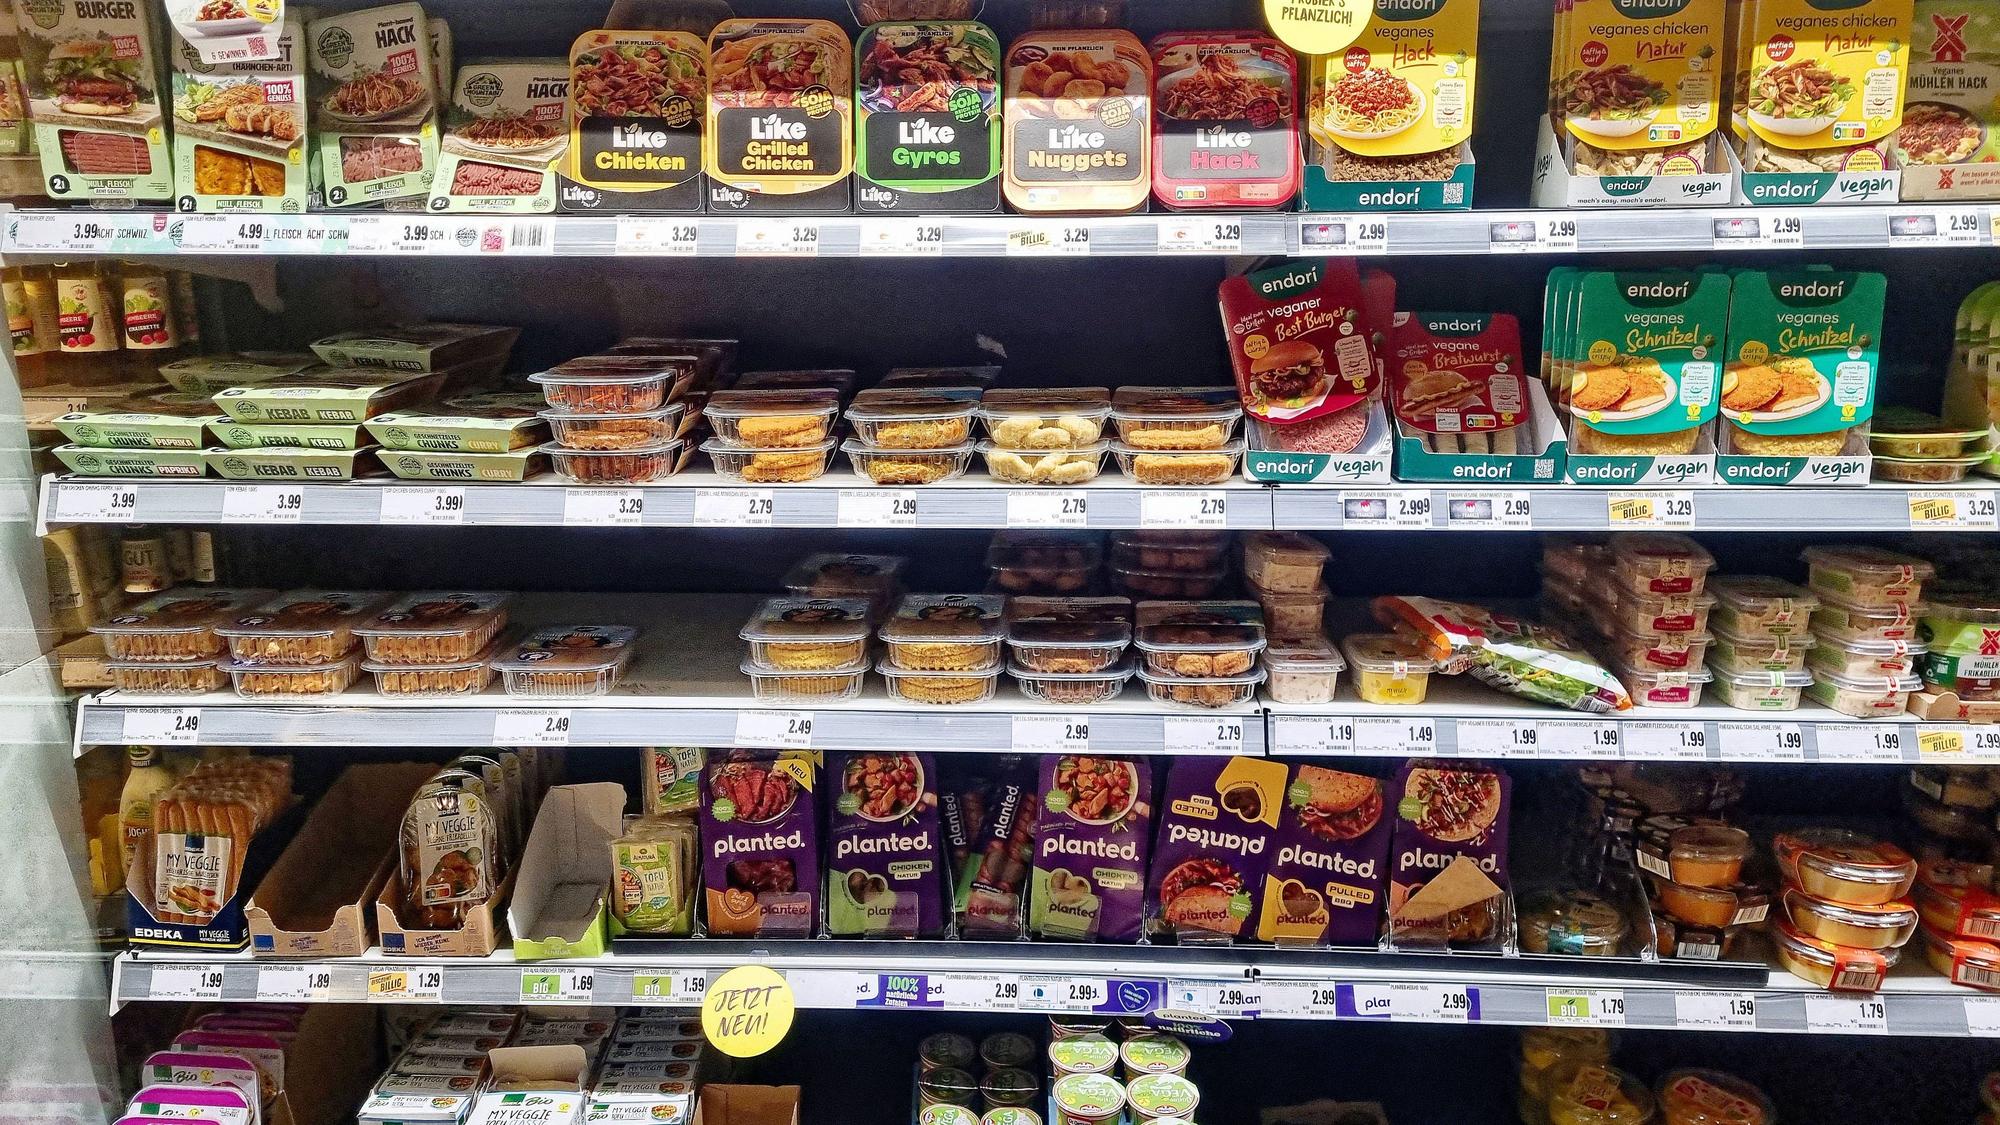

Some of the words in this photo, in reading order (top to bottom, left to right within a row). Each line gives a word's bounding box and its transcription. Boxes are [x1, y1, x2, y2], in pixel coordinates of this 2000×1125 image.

[76, 1, 136, 19] BURGER
[1282, 8, 1352, 27] PFLANZLICH!
[1776, 16, 1838, 31] veganes
[1842, 14, 1896, 27] chicken
[376, 25, 416, 48] HACK
[1374, 25, 1434, 41] veganes
[1589, 25, 1649, 38] veganes
[1653, 24, 1709, 35] chicken
[113, 37, 138, 49] 100%
[390, 52, 416, 67] 100%
[1393, 41, 1436, 66] Hack
[232, 61, 293, 73] (HÄHNCHEN-ART)
[1933, 67, 1964, 75] Veganes
[265, 84, 292, 96] 100%
[527, 82, 568, 98] HACK
[1910, 76, 1954, 89] MÜHLEN
[1959, 77, 1988, 89] HACK
[267, 95, 292, 103] GENUSS
[534, 106, 561, 117] 100%
[751, 114, 807, 140] Like
[899, 119, 955, 144] Like
[613, 126, 667, 148] Like
[1048, 125, 1104, 149] Like
[1197, 129, 1252, 148] Like
[747, 142, 808, 156] Grilled
[595, 152, 685, 170] Chicken
[742, 157, 813, 171] Chicken
[892, 149, 961, 168] Gyros
[1028, 151, 1127, 171] Nuggets
[1190, 152, 1259, 170] Hack
[1682, 182, 1721, 197] vegan
[1841, 178, 1893, 200] vegan
[73, 223, 97, 239] 3.99
[238, 223, 262, 239] 4.99
[1550, 222, 1575, 237] 2.99
[1775, 218, 1801, 233] 2.99
[1951, 216, 1978, 231] 2.99
[404, 224, 428, 240] 3.99
[672, 226, 696, 241] 3.29
[793, 226, 817, 241] 3.29
[917, 227, 941, 242] 3.29
[1064, 228, 1088, 242] 3.29
[1215, 225, 1240, 240] 3.29
[1359, 224, 1385, 240] 2.99
[1267, 298, 1321, 317] veganer
[1624, 313, 1684, 326] veganes
[1776, 312, 1839, 326] veganes
[1627, 325, 1699, 349] Schnitzel
[1778, 324, 1855, 348] Schnitzel
[1433, 341, 1480, 351] vegane
[1433, 351, 1501, 368] Bratwurst
[268, 408, 310, 420] KEBAB
[319, 410, 352, 420] KEBAB
[108, 438, 150, 446] CHUNKS
[156, 438, 194, 447] PAPRIKA
[261, 435, 300, 447] KEBAB
[310, 438, 343, 448] KEBAB
[417, 439, 458, 449] CHUNKS
[468, 440, 498, 449] CURRY
[110, 465, 153, 474] CHUNKS
[159, 466, 197, 475] PAPRIKA
[254, 465, 297, 476] KEBAB
[306, 466, 340, 477] KEBAB
[430, 468, 472, 478] CHUNKS
[481, 469, 512, 478] CURRY
[1333, 459, 1383, 478] vegan
[1657, 461, 1708, 480] vegan
[1811, 460, 1865, 480] vegan
[111, 492, 135, 508] 3.99
[278, 495, 300, 509] 3.99
[619, 498, 642, 514] 3.29
[749, 499, 772, 515] 2.79
[893, 500, 916, 514] 2.99
[1063, 499, 1086, 513] 2.79
[1201, 499, 1225, 513] 2.79
[1505, 500, 1530, 513] 2.99
[1666, 500, 1692, 514] 3.29
[1623, 507, 1648, 518] BILLIG
[1925, 505, 1949, 520] BILLIG
[1969, 500, 1995, 516] 3.29
[175, 717, 198, 731] 2.49
[546, 718, 569, 732] 2.49
[788, 719, 811, 734] 2.49
[1066, 724, 1088, 739] 2.99
[1217, 725, 1240, 740] 2.79
[1328, 725, 1352, 740] 1.19
[1409, 726, 1432, 741] 1.49
[1512, 729, 1536, 744] 1.99
[1593, 730, 1617, 745] 1.99
[1680, 731, 1704, 746] 1.99
[1776, 733, 1801, 748] 1.99
[1874, 735, 1899, 750] 1.99
[1933, 739, 1957, 751] BILLIG
[1976, 734, 2000, 749] 2.99
[788, 763, 807, 779] NEU
[995, 785, 1020, 838] planted.
[425, 820, 439, 834] MY
[442, 818, 475, 834] VEGGIE
[714, 831, 805, 857] planted.
[837, 832, 932, 858] planted.
[1168, 823, 1265, 856] planted.
[1043, 834, 1139, 861] planted.
[166, 854, 180, 868] MY
[184, 854, 220, 871] VEGGIE
[890, 864, 930, 872] CHICKEN
[1278, 844, 1378, 880] planted.
[1096, 870, 1134, 880] CHICKEN
[1329, 886, 1371, 900] PULLED
[1179, 910, 1229, 921] planted.
[1276, 914, 1327, 925] planted.
[135, 928, 182, 940] EDEKA
[201, 973, 222, 987] 1.99
[308, 974, 330, 988] 1.89
[380, 980, 402, 992] BILLIG
[419, 972, 440, 987] 1.29
[571, 974, 593, 988] 1.69
[683, 978, 705, 992] 1.59
[887, 975, 919, 991] 100%
[533, 984, 548, 993] BIO
[644, 983, 660, 995] BIO
[886, 991, 918, 1000] natürliche
[995, 982, 1018, 997] 2.99
[1069, 985, 1091, 1000] 2.99
[714, 987, 782, 1010] JETZT
[1219, 989, 1241, 1005] 2.99
[1312, 990, 1335, 1005] 2.99
[1443, 994, 1466, 1009] 2.99
[1560, 1004, 1577, 1017] BIO
[1601, 999, 1624, 1014] 1.79
[1730, 1000, 1754, 1015] 1.59
[1859, 1004, 1884, 1018] 1.79
[717, 1013, 767, 1038] NEU!
